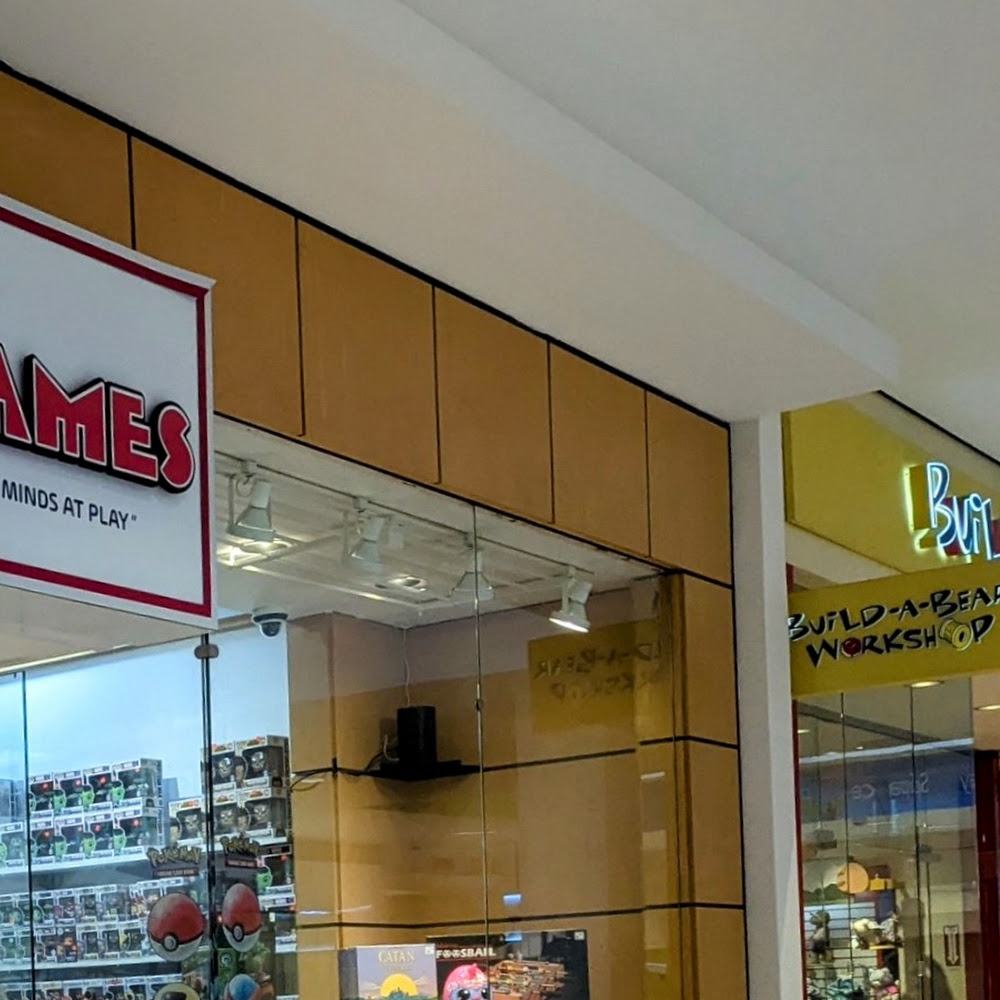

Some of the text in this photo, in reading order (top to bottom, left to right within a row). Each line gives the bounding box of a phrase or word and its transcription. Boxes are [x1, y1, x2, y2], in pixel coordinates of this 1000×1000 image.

[2, 479, 59, 515] MINDS
[63, 498, 86, 518] AT
[806, 614, 996, 669] WORKSHOP
[378, 951, 415, 963] CATAN
